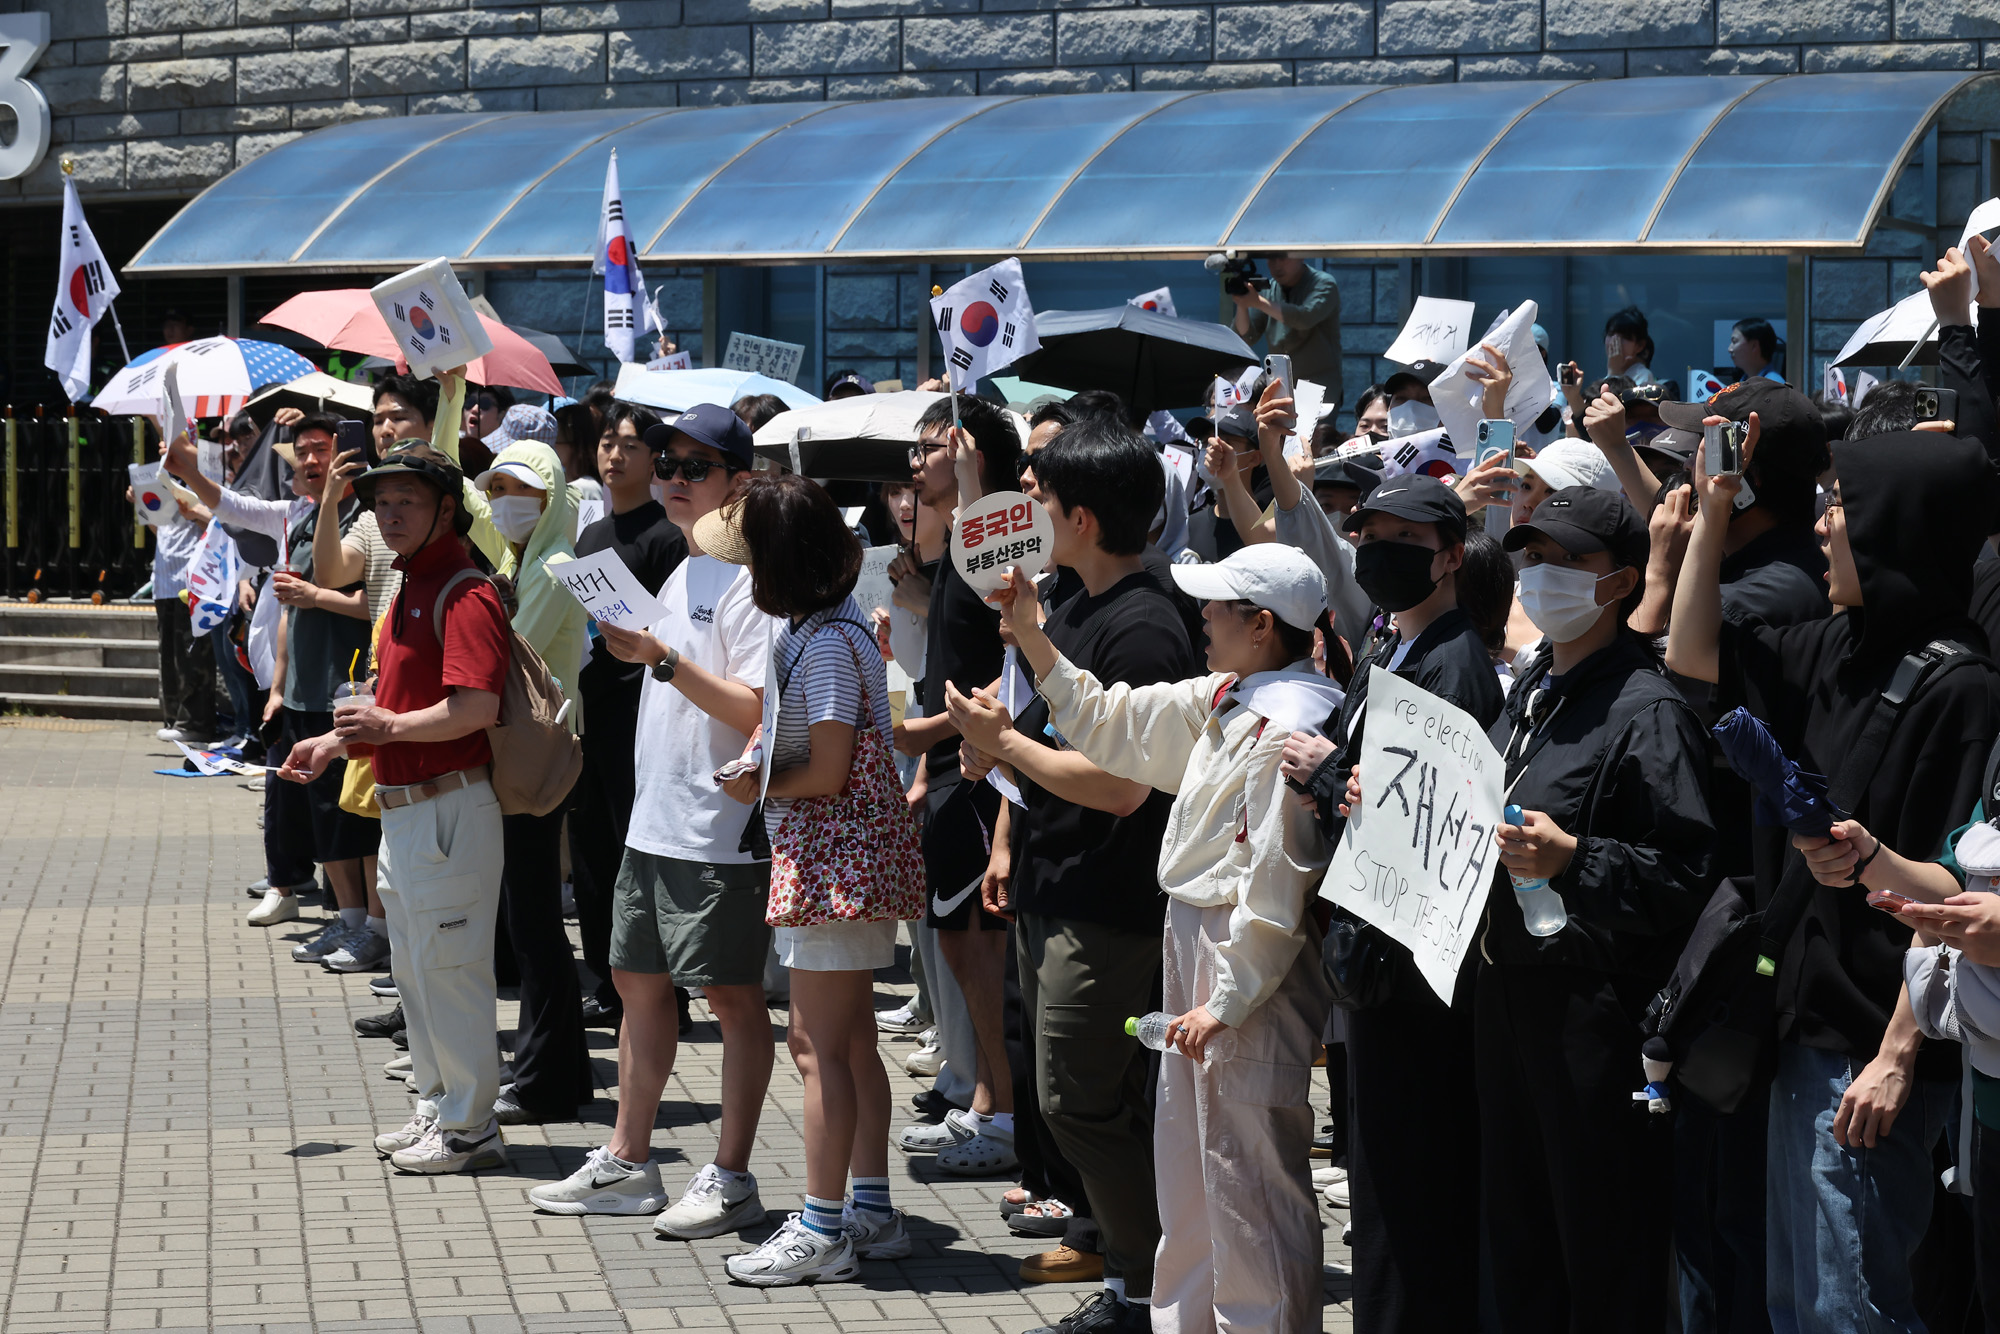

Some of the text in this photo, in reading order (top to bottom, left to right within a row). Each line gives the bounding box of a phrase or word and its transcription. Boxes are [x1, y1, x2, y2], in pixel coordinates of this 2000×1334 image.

[733, 337, 762, 355] 국민의
[1411, 321, 1458, 350] 재선거
[728, 352, 751, 367] 유린한
[961, 500, 1033, 549] 중국인
[966, 536, 1042, 574] 부동산장악
[1394, 697, 1484, 774] re election
[1376, 746, 1495, 932] 재선거
[1349, 849, 1464, 974] STOP THE STEAL
[785, 1245, 807, 1262] N
